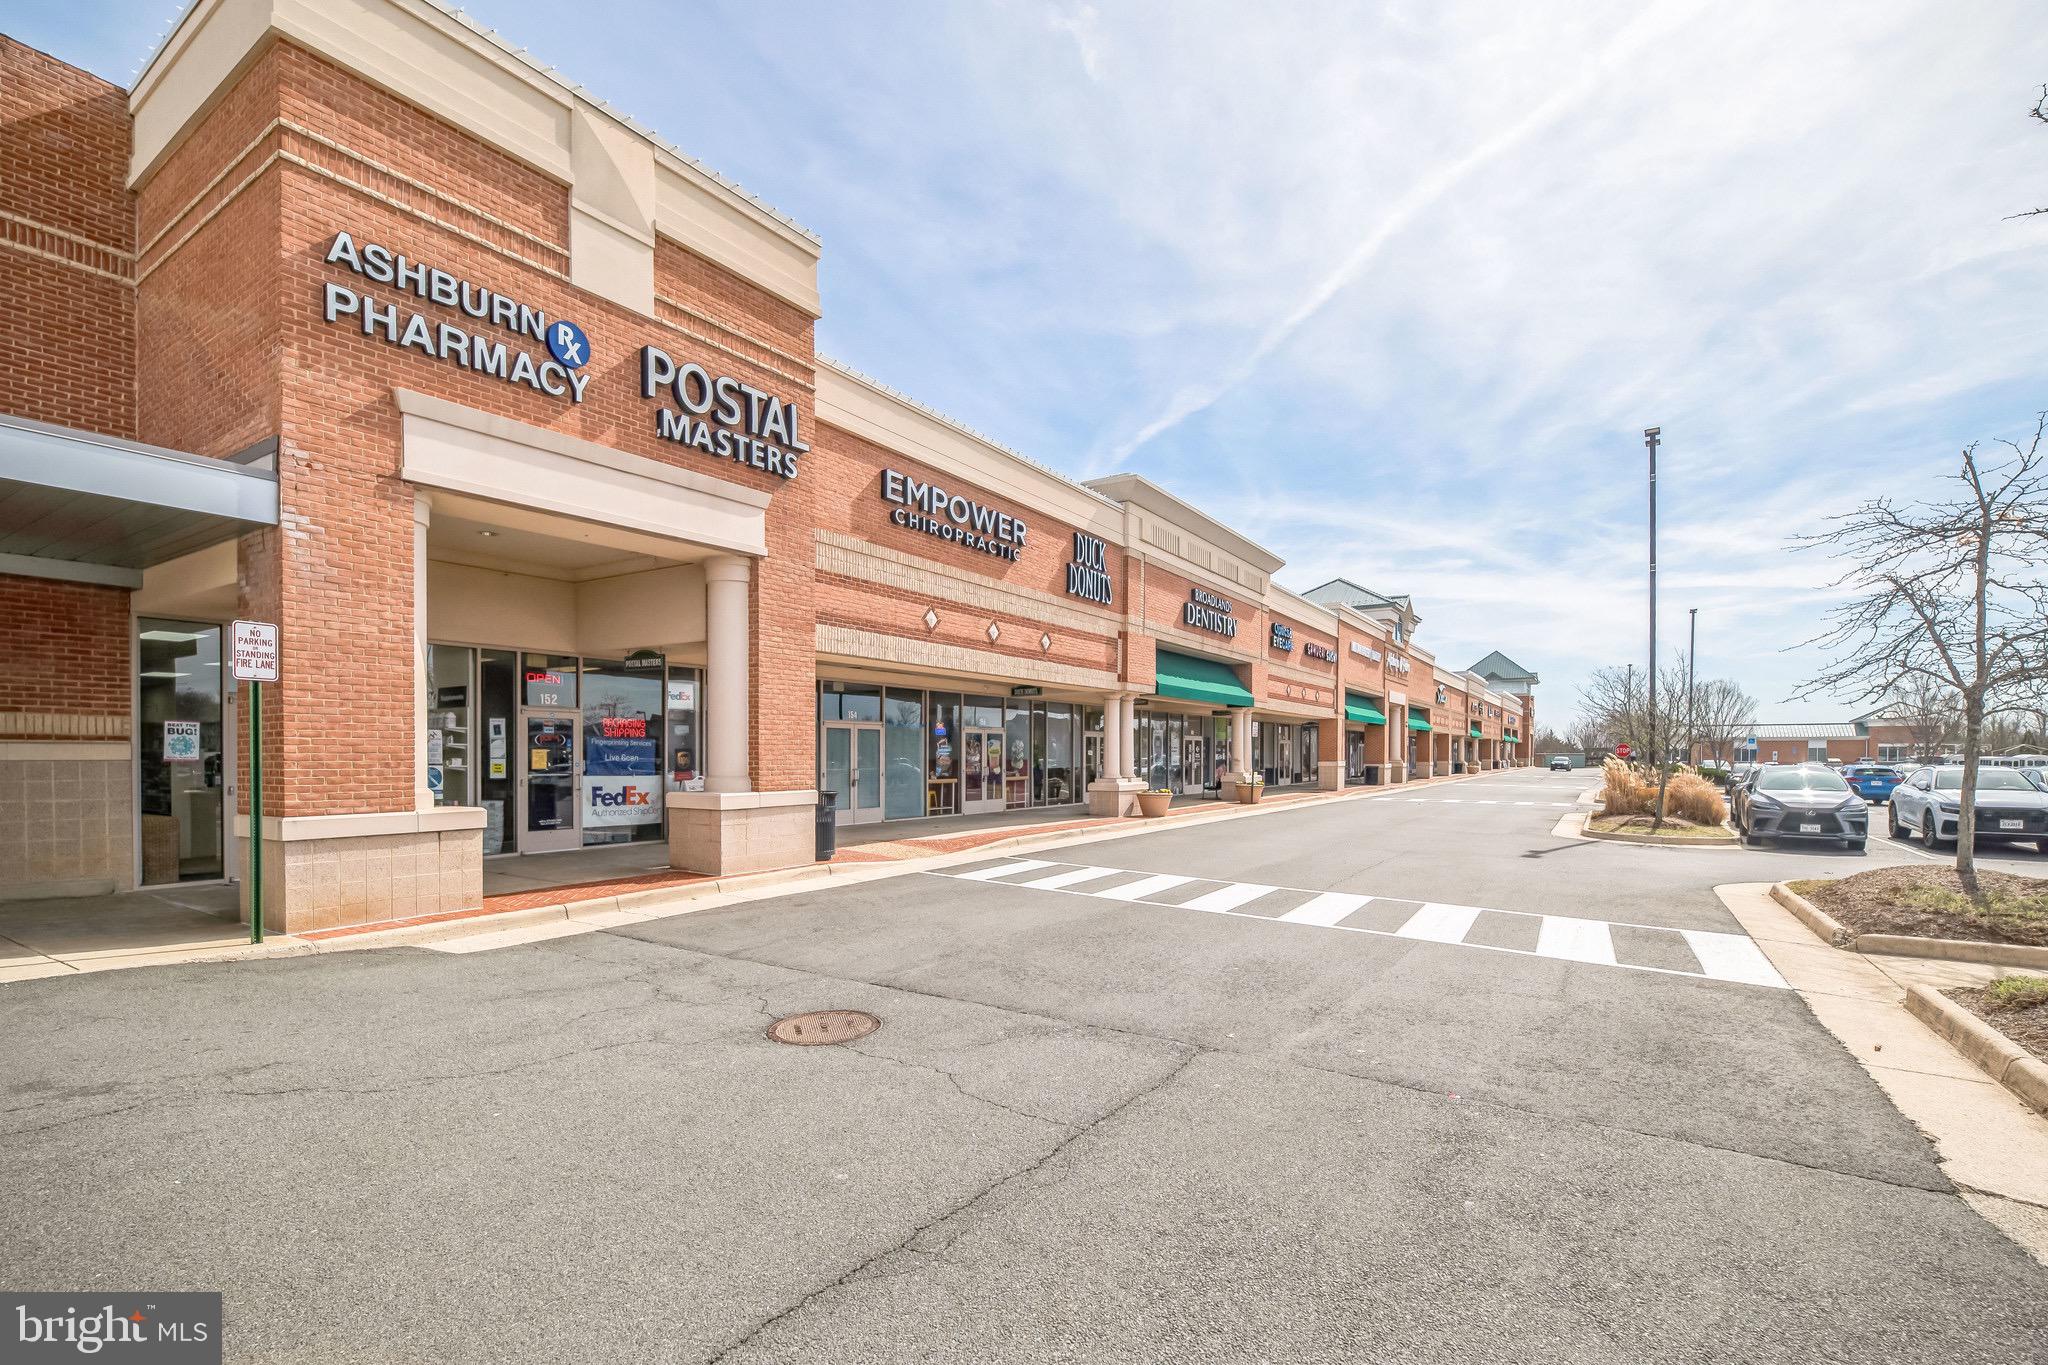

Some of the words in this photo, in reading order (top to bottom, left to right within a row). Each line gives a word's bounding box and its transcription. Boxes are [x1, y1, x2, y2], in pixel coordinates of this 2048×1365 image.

[325, 230, 546, 342] ASHBURN
[323, 282, 591, 403] PHARMACY
[641, 344, 810, 452] POSTAL
[657, 408, 799, 479] MASTERS
[881, 468, 1027, 546] EMPOWER
[890, 508, 1022, 562] CHIROPRACTIC
[1074, 532, 1108, 572] DUCK
[1066, 563, 1112, 605] DONUTS
[1192, 588, 1233, 613] BROADLANDS
[1185, 602, 1238, 637] DENTISTRY
[249, 629, 261, 637] NO
[238, 636, 273, 648] PARKING
[236, 649, 275, 660] STANDING
[236, 658, 253, 668] FIRE
[255, 659, 275, 670] LANE
[526, 672, 561, 684] OPEN
[540, 693, 558, 705] 152
[167, 727, 197, 736] BUG!
[603, 727, 647, 738] SHIPPING
[591, 738, 629, 747] Fingerprinting
[604, 753, 620, 761] Live
[621, 753, 639, 761] Scan
[591, 785, 650, 806] FedEx
[591, 807, 633, 817] Authorized
